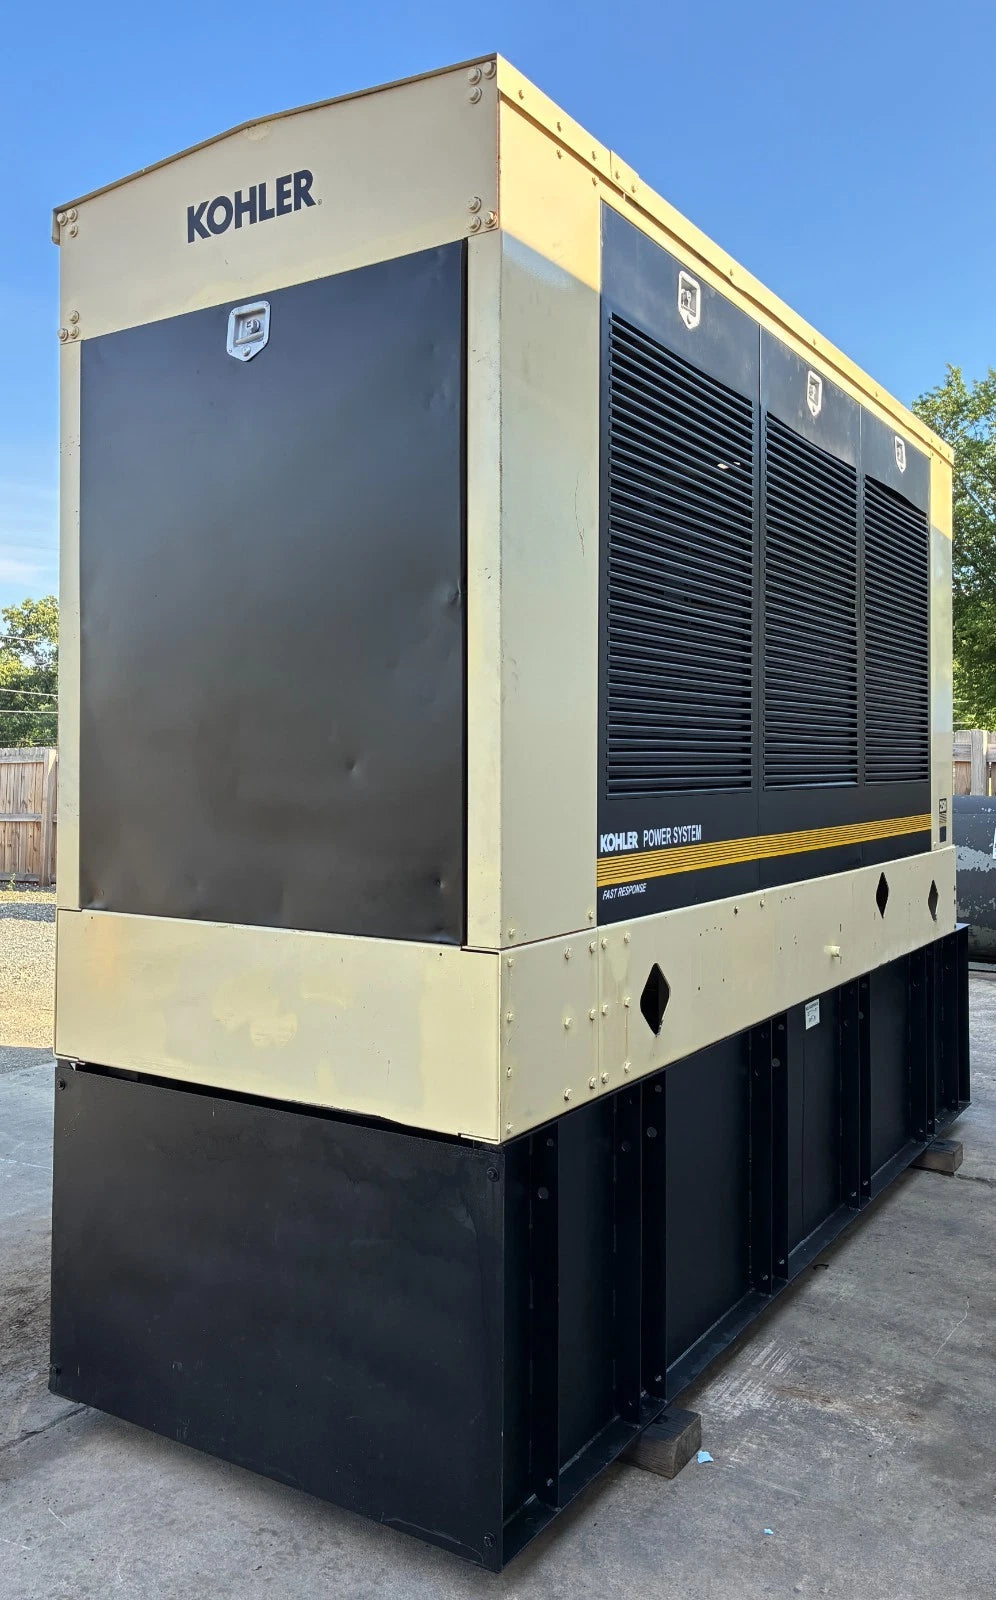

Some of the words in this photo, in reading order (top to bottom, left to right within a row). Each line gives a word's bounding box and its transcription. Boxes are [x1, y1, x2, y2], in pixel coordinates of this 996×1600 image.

[187, 169, 316, 243] KOHLER
[600, 831, 638, 852] KOHLER
[643, 827, 672, 847] POWER
[673, 824, 702, 843] SYSTEM
[602, 888, 617, 900] FAST
[617, 883, 647, 897] RESPONSE
